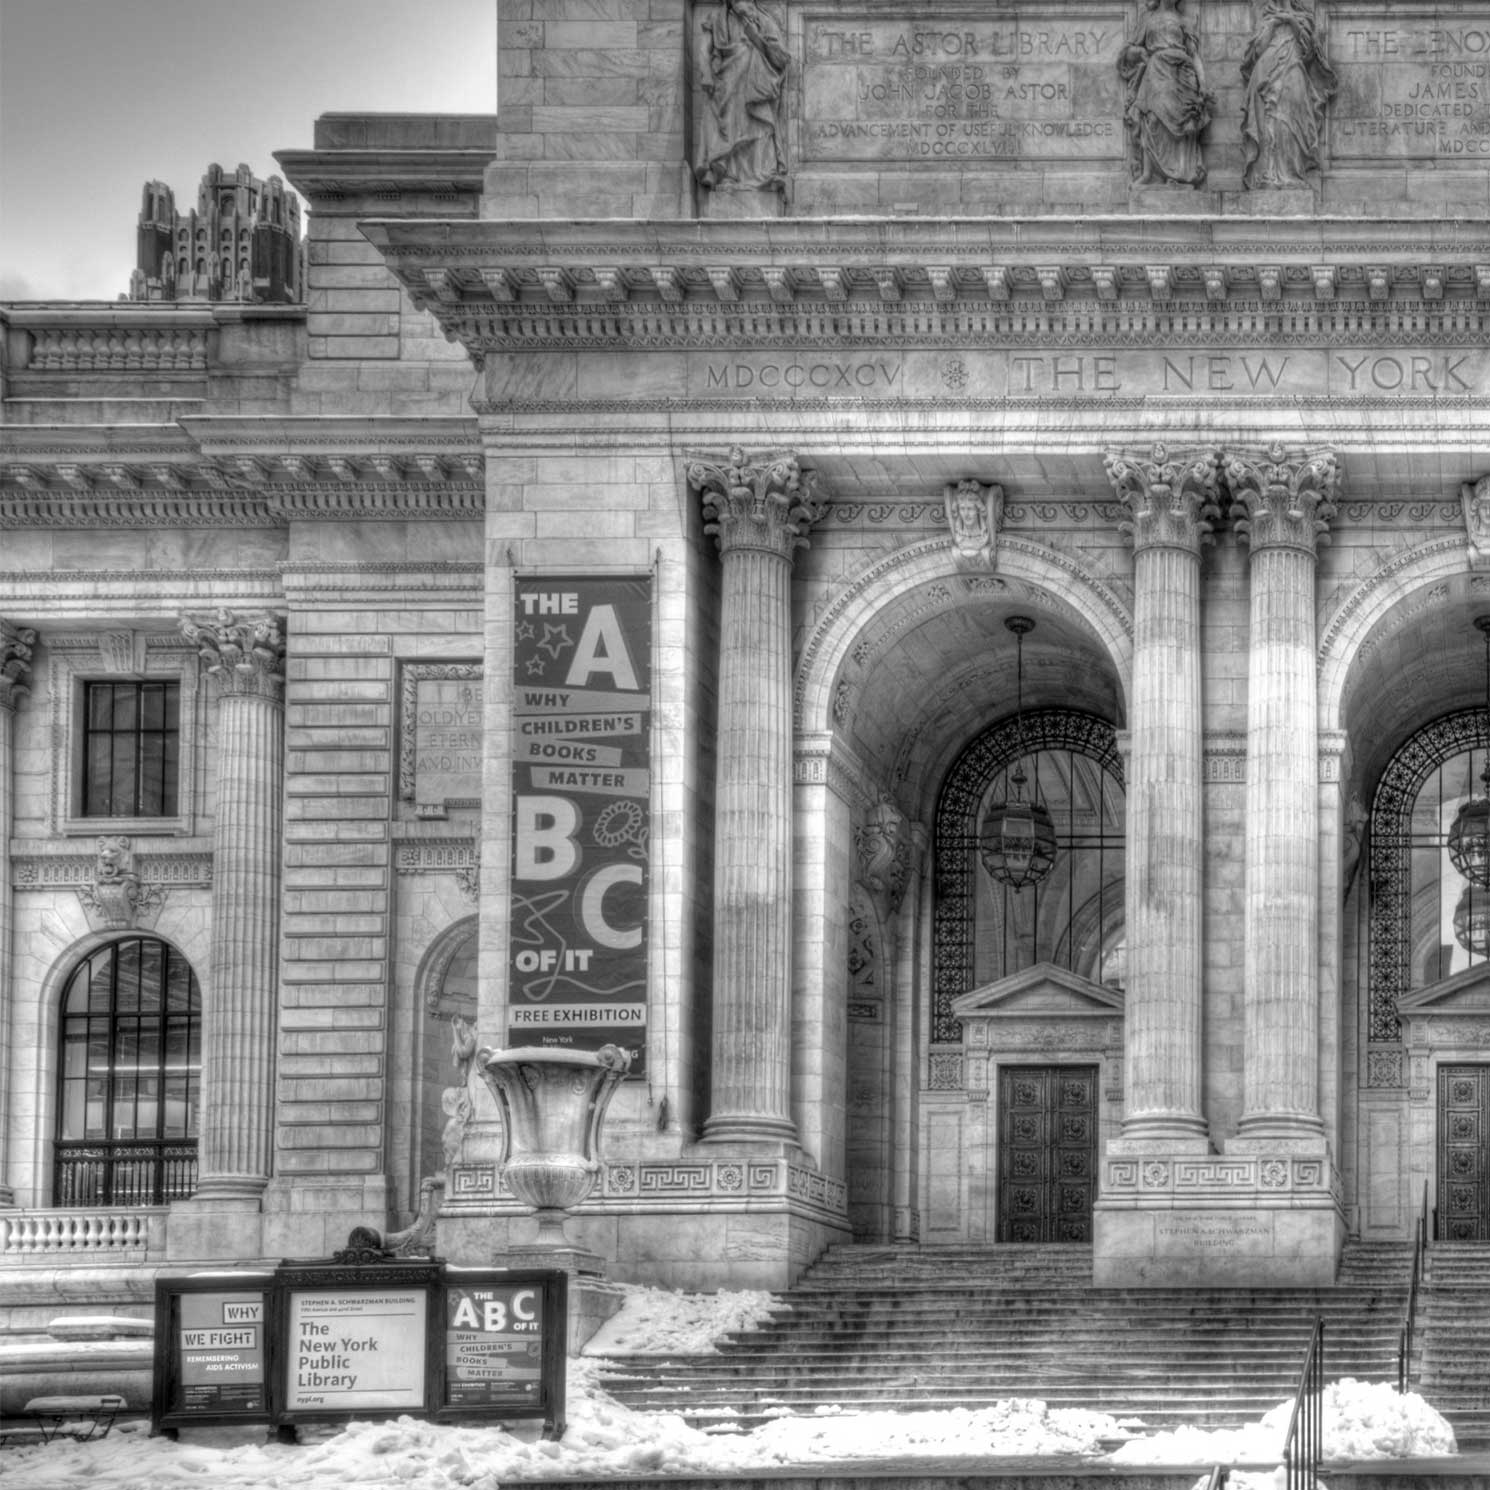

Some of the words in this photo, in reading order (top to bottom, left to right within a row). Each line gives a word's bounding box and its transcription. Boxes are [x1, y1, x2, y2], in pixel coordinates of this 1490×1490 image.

[821, 31, 874, 57] THE
[891, 31, 978, 57] ASTOR
[992, 31, 1107, 57] LIBRARY
[1346, 29, 1400, 55] THE
[904, 66, 985, 81] FOUNDED
[1001, 66, 1021, 81] BY
[858, 83, 914, 101] JOHN
[923, 83, 992, 101] JACOB
[1007, 83, 1069, 101] ASTOR
[1408, 81, 1479, 99] JAMES
[926, 104, 957, 120] FOR
[966, 104, 1001, 120] THE
[1382, 103, 1473, 118] DEDICATED
[817, 122, 931, 138] ADVANCEMENT
[936, 122, 957, 138] OF
[962, 122, 1018, 138] USEFUL
[1022, 122, 1113, 138] KNOWLEDGE
[1342, 121, 1447, 136] LITERATURE
[706, 362, 902, 390] MDCCCXCV
[1012, 356, 1124, 393] THE
[1161, 355, 1292, 392] NEW
[1342, 355, 1480, 392] YORK
[520, 592, 579, 616] THE
[564, 603, 640, 690] A
[524, 692, 571, 708] WHY
[418, 710, 454, 726] OLD
[520, 716, 635, 736] CHILDREN'S
[528, 742, 598, 762] BOOKS
[417, 755, 451, 771] AND
[548, 770, 626, 788] MATTER
[515, 795, 580, 881] B
[581, 863, 643, 950] C
[515, 950, 558, 973] OF
[564, 948, 594, 972] IT
[514, 1009, 550, 1022] FREE
[553, 1008, 642, 1022] EXHIBITION
[542, 1036, 558, 1044] New
[559, 1035, 574, 1044] York
[384, 1296, 416, 1305] BUILDING
[473, 1291, 494, 1301] THE
[227, 1306, 260, 1319] WHY
[300, 1321, 329, 1336] The
[513, 1322, 528, 1331] OF
[528, 1322, 539, 1331] IT
[184, 1333, 206, 1346] WE
[210, 1331, 253, 1345] FIGHT
[300, 1339, 337, 1353] New
[341, 1337, 379, 1352] York
[456, 1333, 478, 1341] WHY
[460, 1343, 513, 1353] CHILDREN'S
[186, 1354, 240, 1363] REMEMBERING
[205, 1363, 223, 1371] AIDS
[224, 1362, 259, 1371] ACTIVISM
[299, 1354, 351, 1370] Public
[456, 1356, 488, 1366] BOOKS
[298, 1372, 358, 1390] Library
[467, 1369, 503, 1378] MATTER
